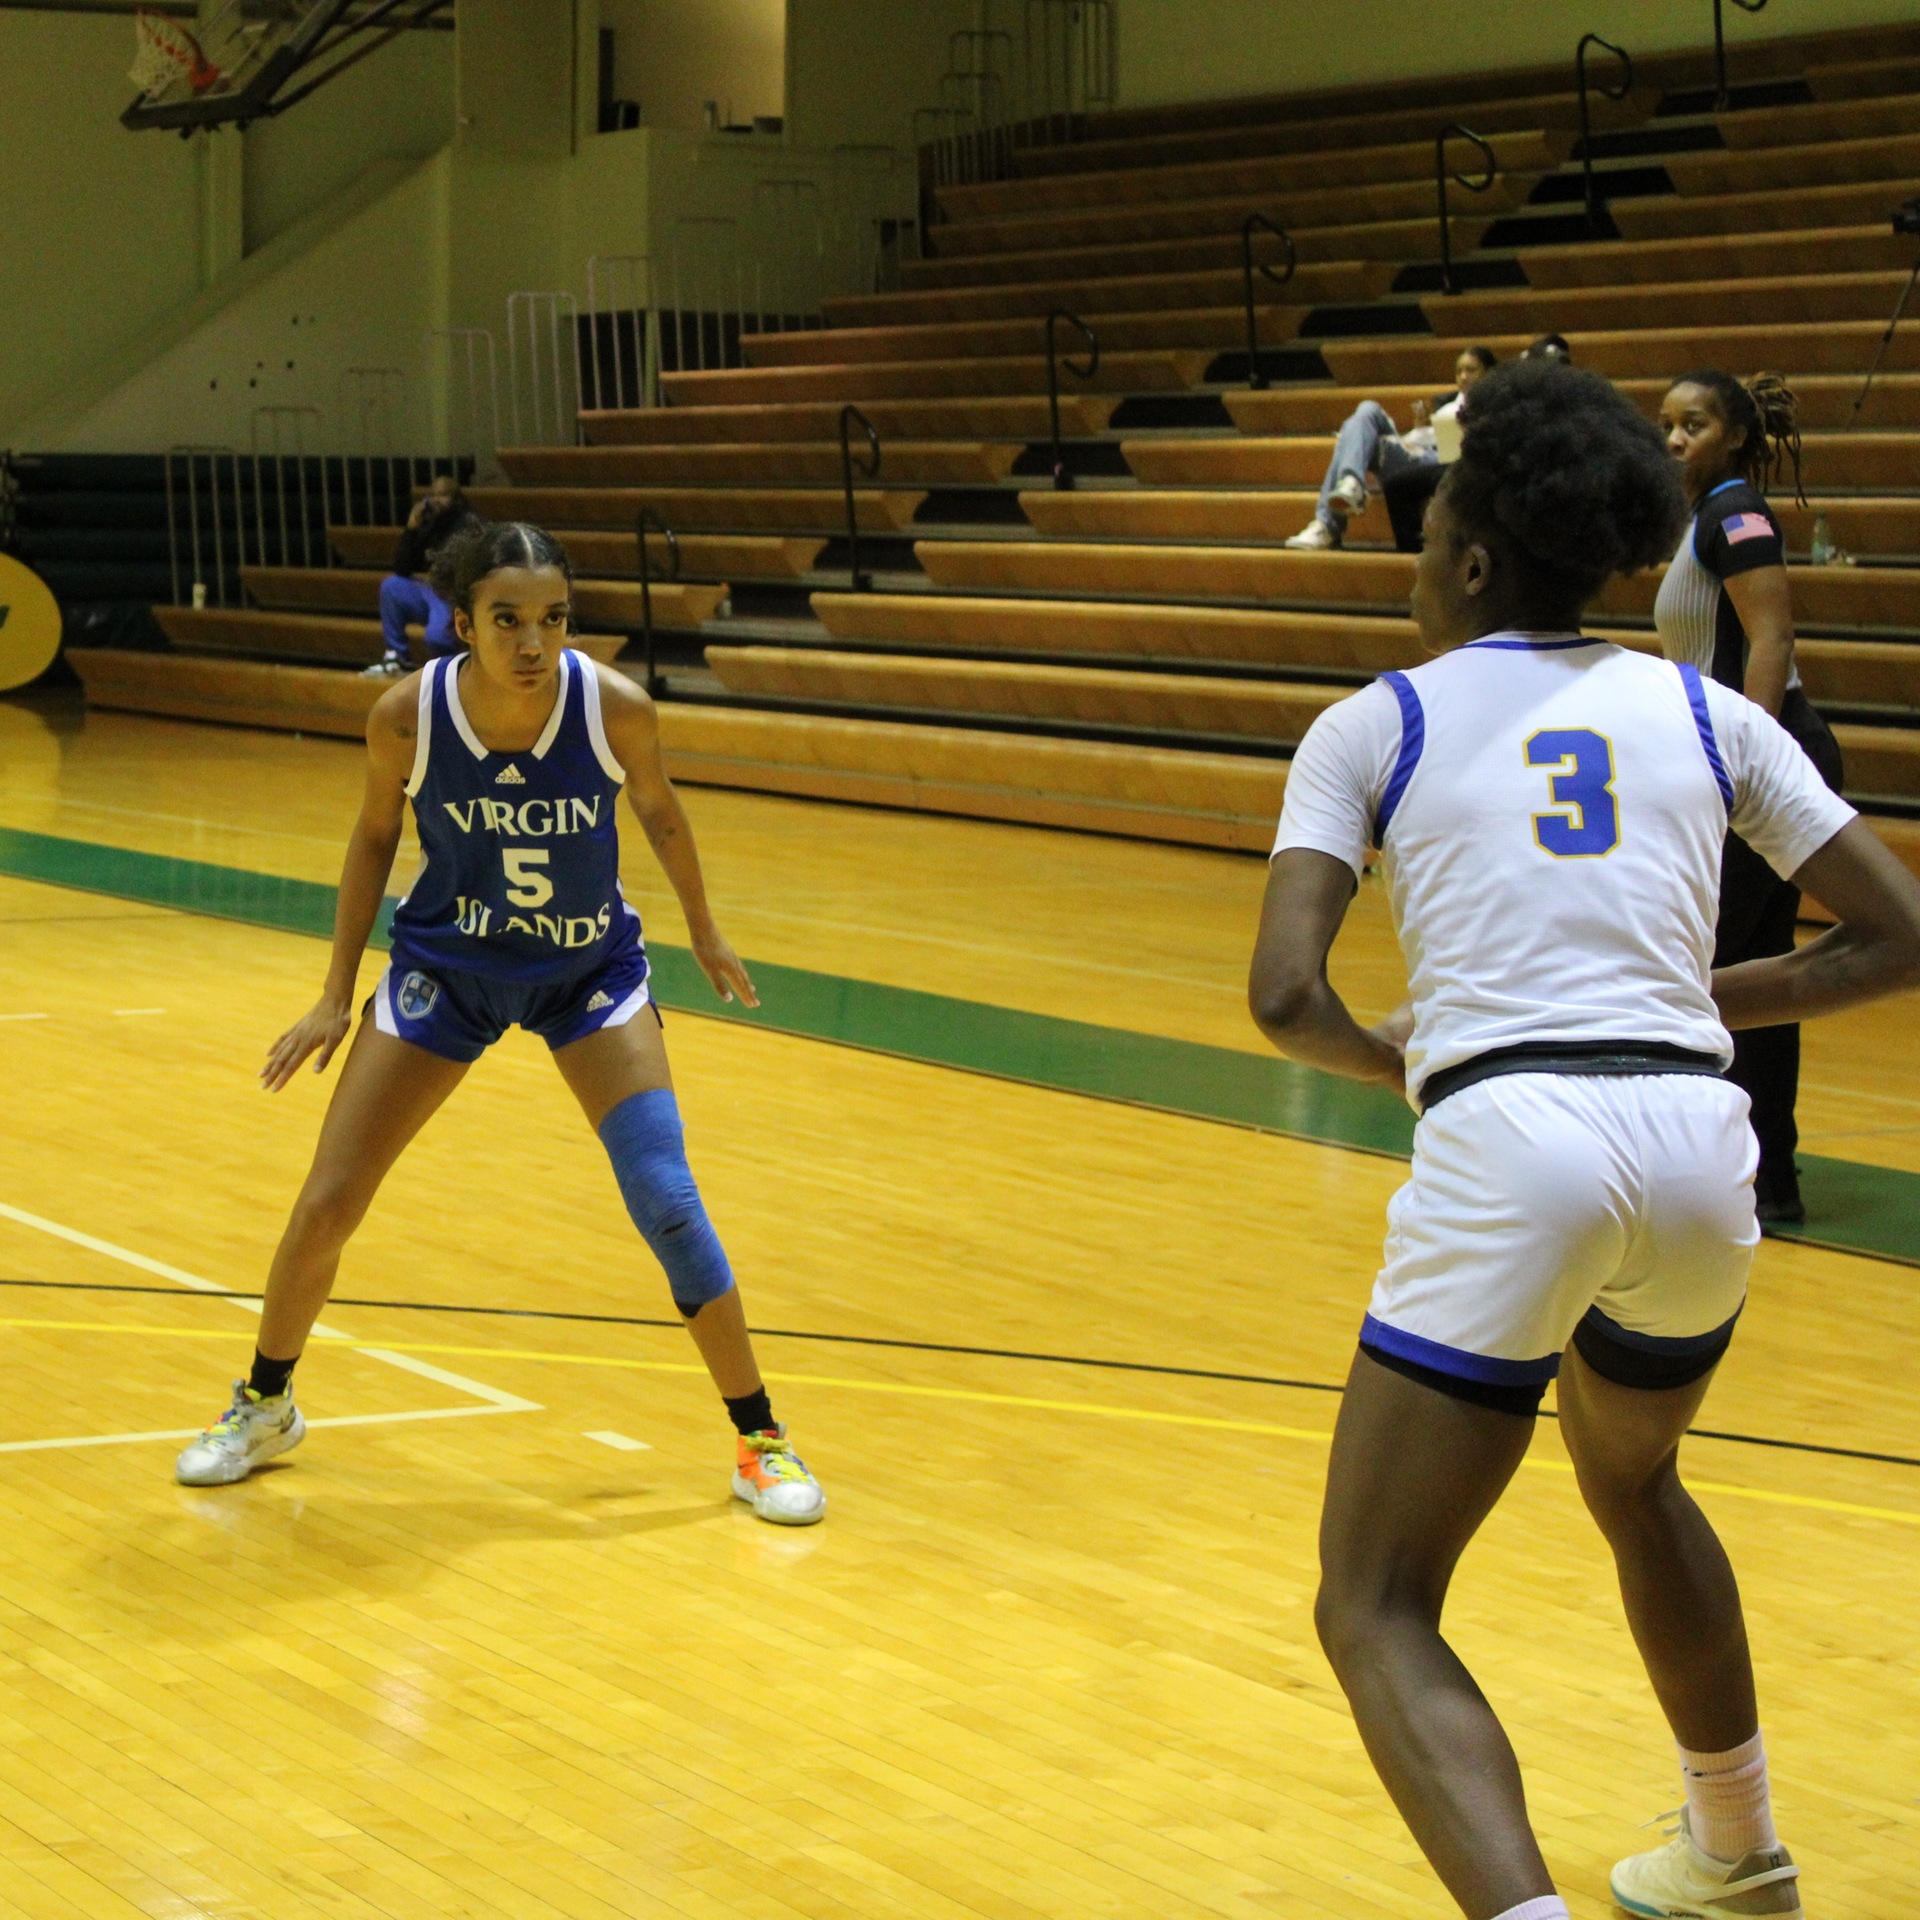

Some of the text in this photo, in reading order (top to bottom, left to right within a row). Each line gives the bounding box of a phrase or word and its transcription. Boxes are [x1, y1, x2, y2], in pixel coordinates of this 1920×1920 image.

[495, 775, 526, 784] adidas
[1521, 726, 1622, 860] 3
[443, 795, 600, 836] VIRGIN
[502, 848, 554, 908] 5
